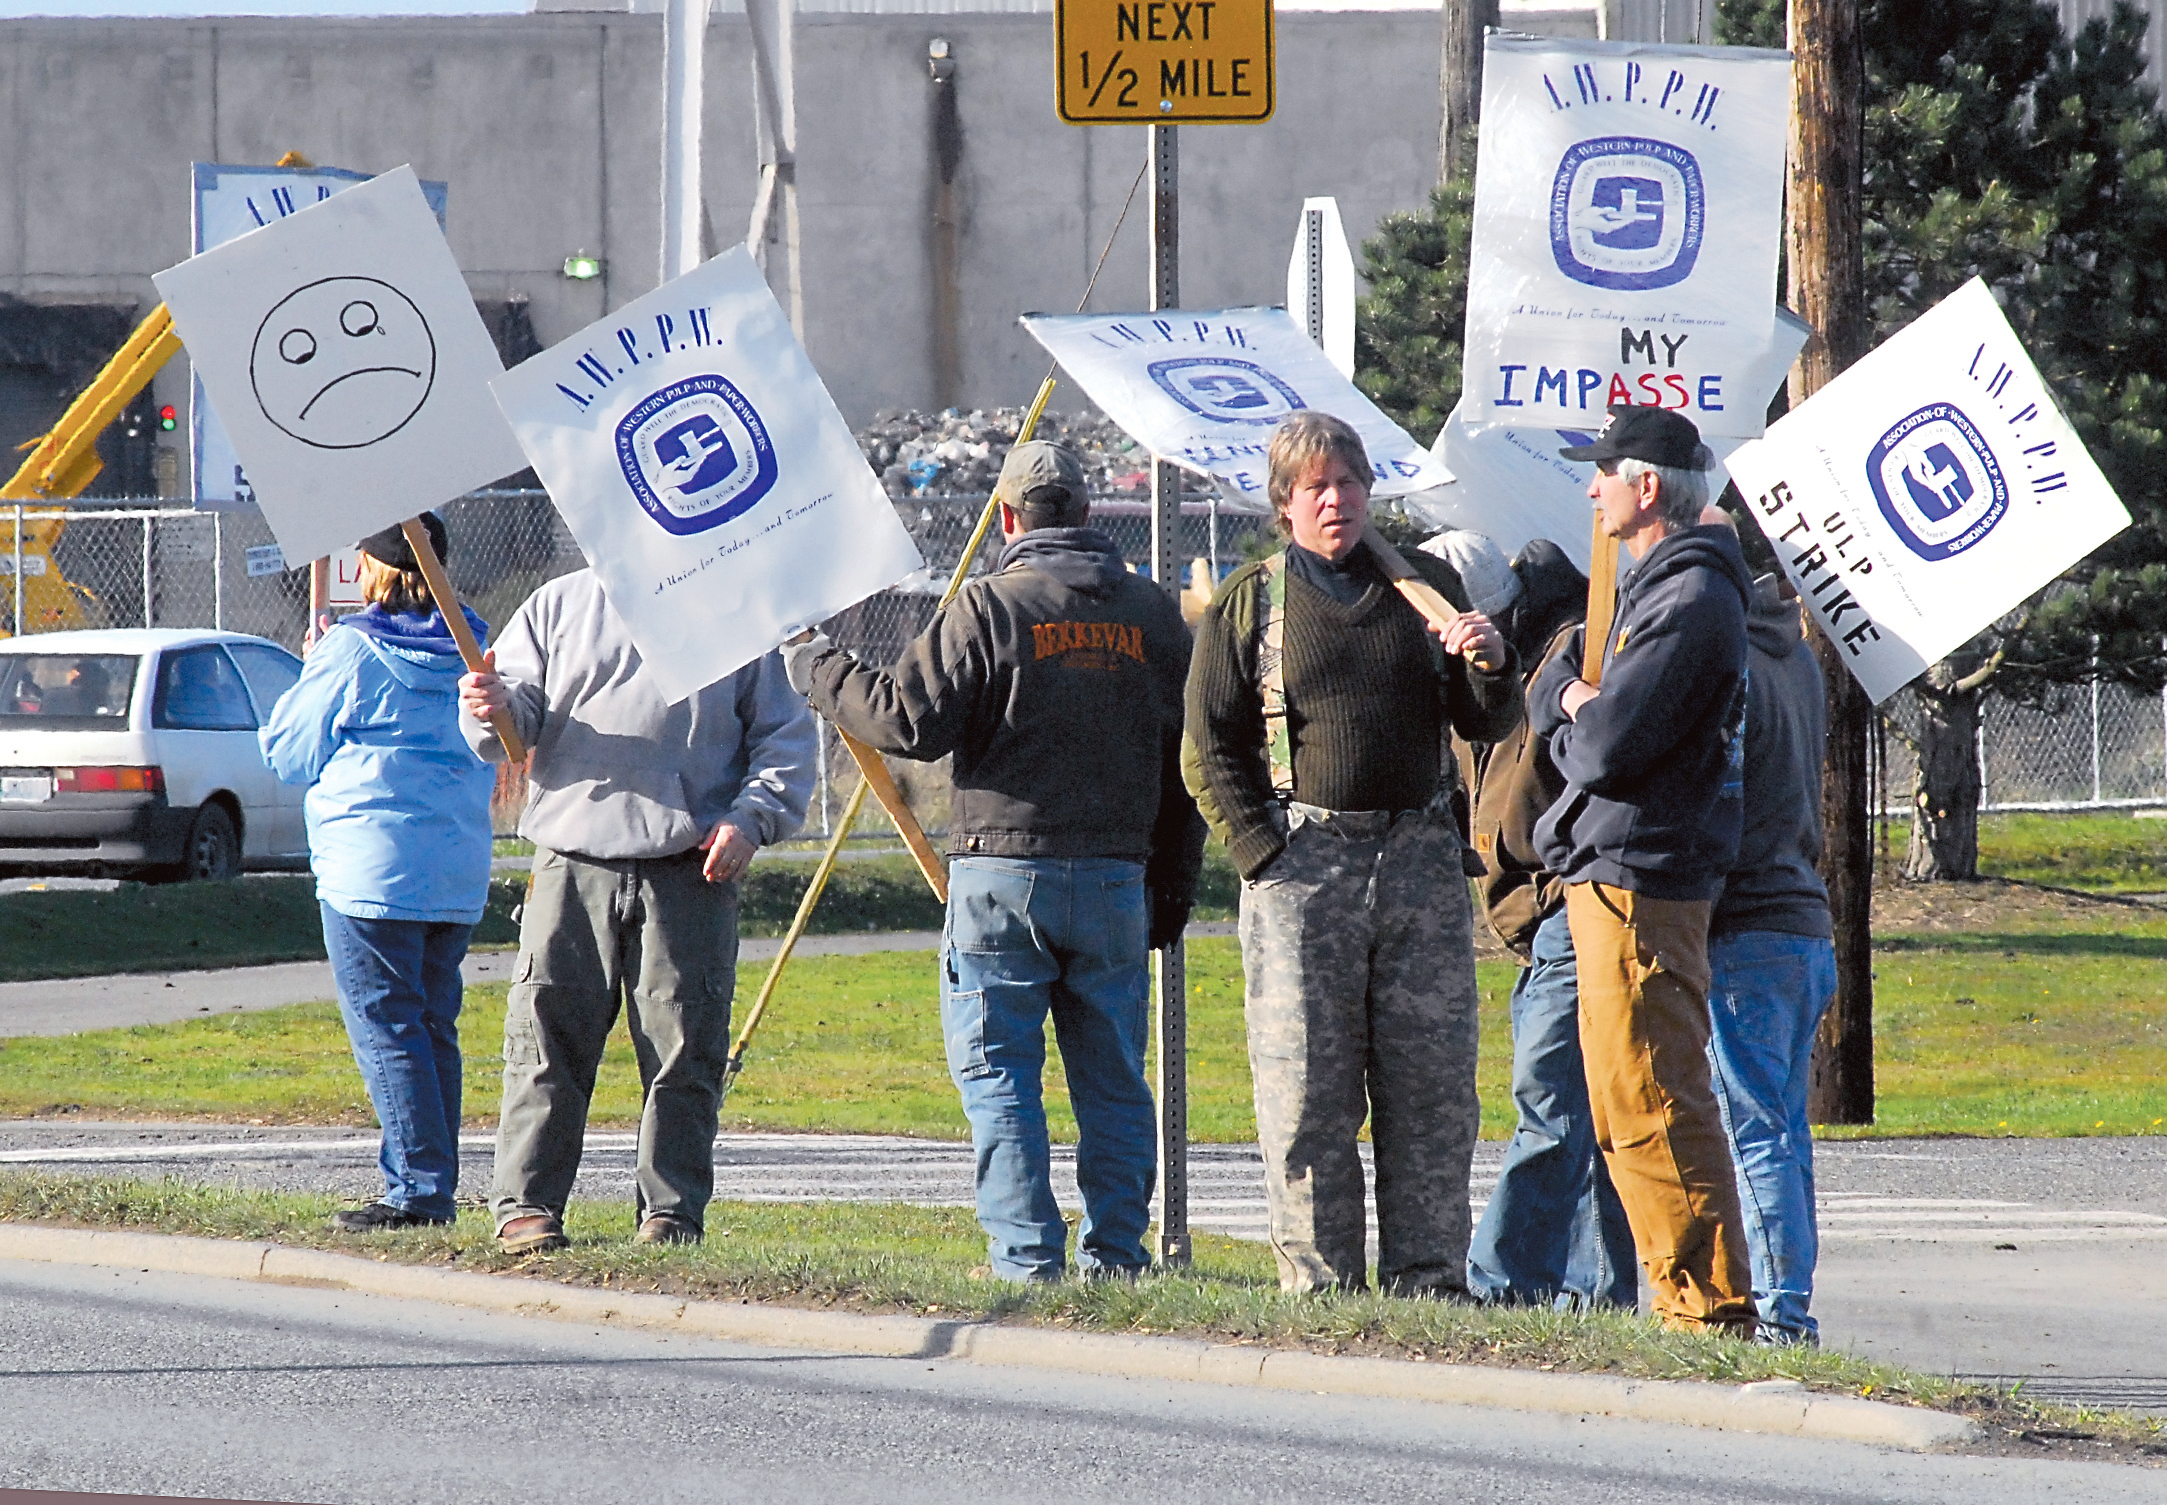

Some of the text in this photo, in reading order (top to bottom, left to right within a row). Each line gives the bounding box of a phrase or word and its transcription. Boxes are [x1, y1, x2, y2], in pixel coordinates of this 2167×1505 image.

[1117, 2, 1216, 41] NEXT
[1080, 50, 1252, 107] 1/2 MILE
[1555, 172, 1571, 241] ASSOCIATION
[1566, 156, 1578, 170] OF
[1578, 141, 1631, 156] WESTERN
[1634, 141, 1661, 153] PULP
[1665, 148, 1687, 165] AND
[1685, 165, 1699, 199] PAPER
[556, 307, 722, 413] A.W.P.P.W.
[1620, 327, 1688, 368] MY
[664, 409, 677, 419] THE
[1494, 365, 1725, 411] IMPASSE
[620, 379, 768, 512] ASSOCIATION OF WESTERN PULP AND PAPER WORKERS
[1882, 406, 2006, 553] ASSOCIATION OF WESTERN PULP AND PAPER WORKERS
[667, 568, 697, 586] Union
[700, 556, 714, 570] for
[785, 492, 834, 520] Tomorrow
[1759, 480, 1881, 656] STRIKE
[1823, 511, 1873, 576] ULP
[1032, 622, 1145, 664] BEKKEVAR
